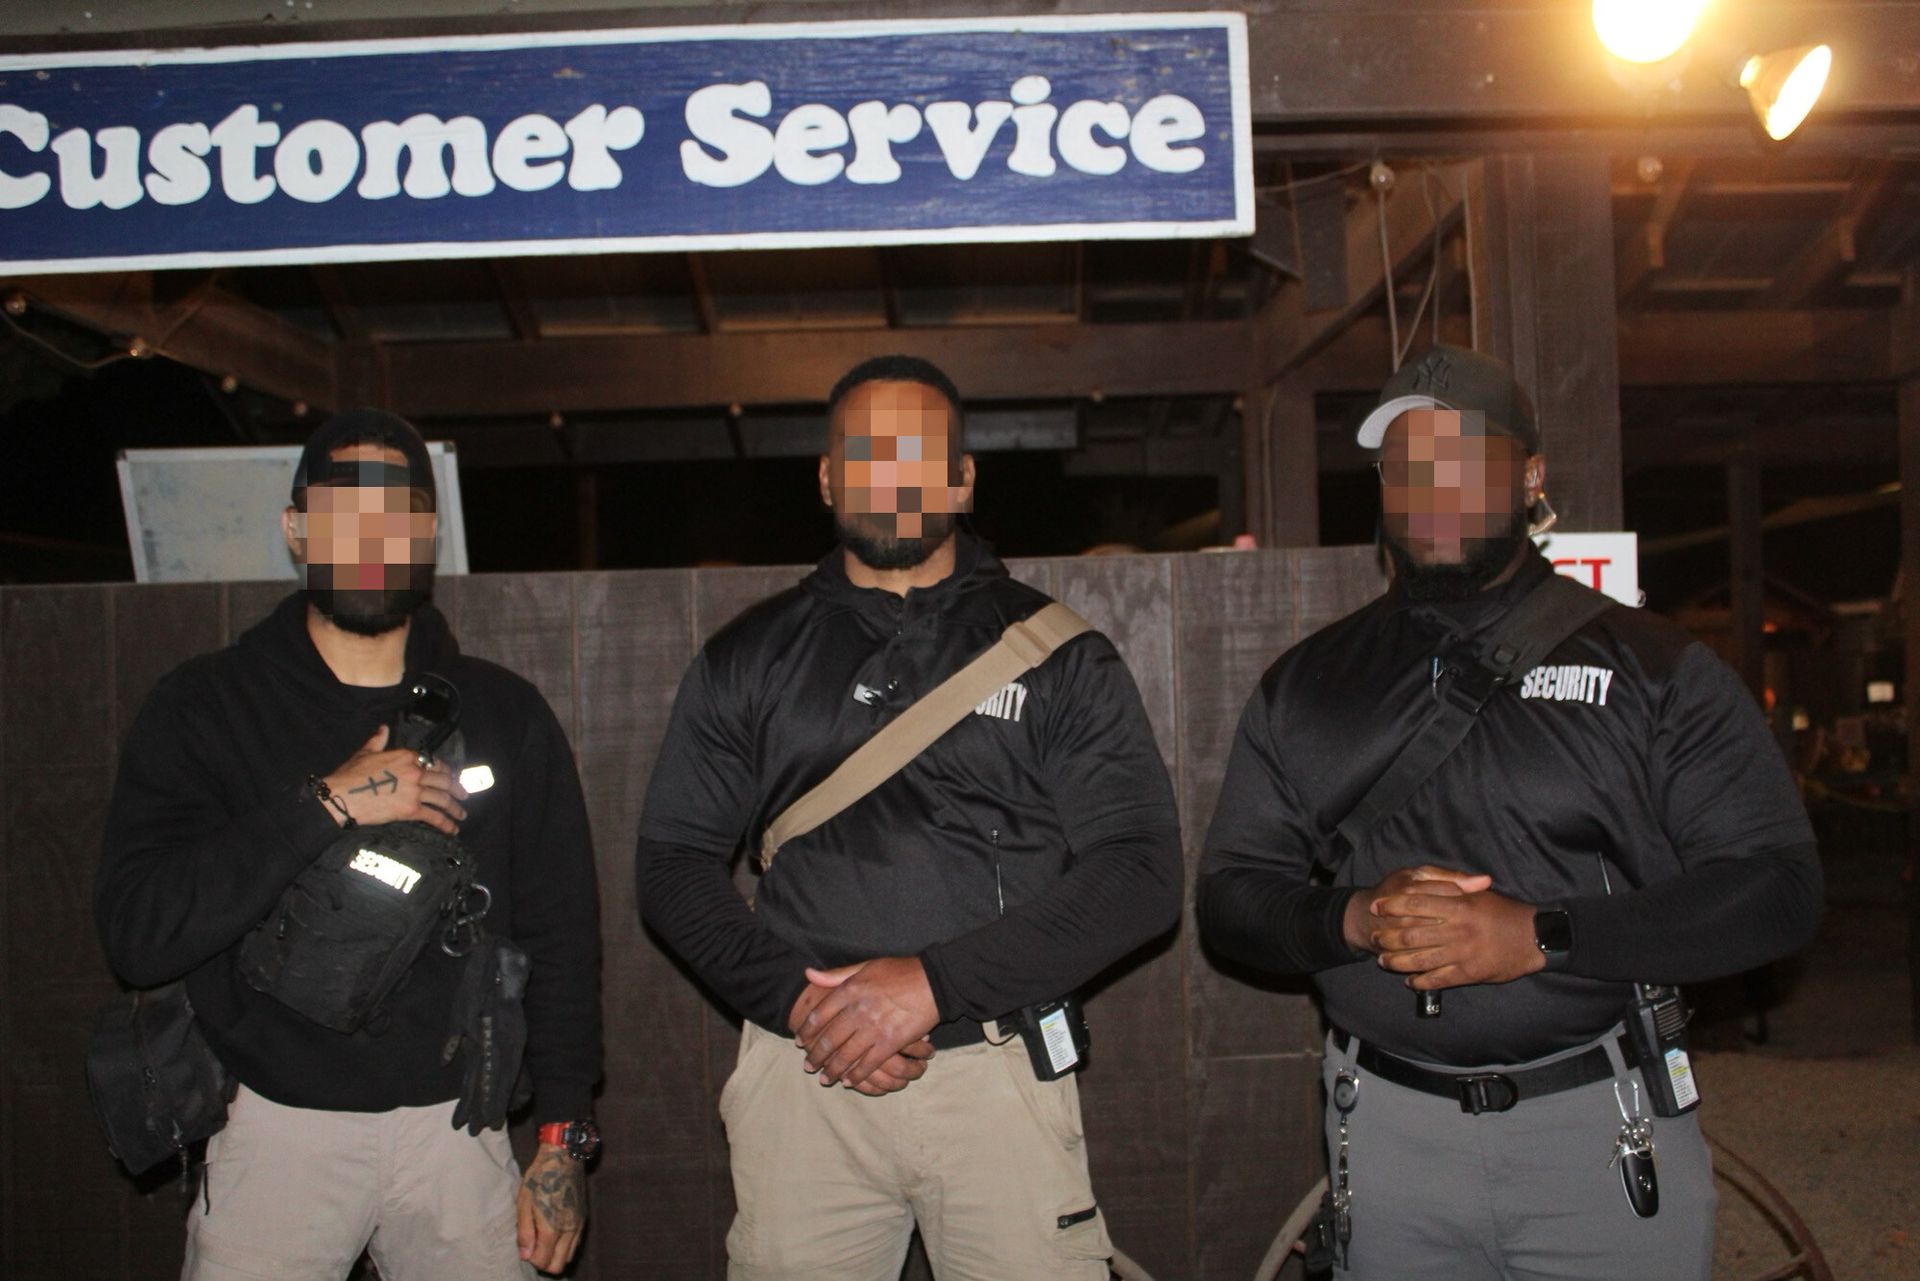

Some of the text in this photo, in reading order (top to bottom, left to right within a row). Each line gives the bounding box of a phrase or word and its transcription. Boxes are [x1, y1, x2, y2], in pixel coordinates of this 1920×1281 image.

[0, 75, 1206, 210] Customer Service
[1520, 664, 1614, 706] SECURITY
